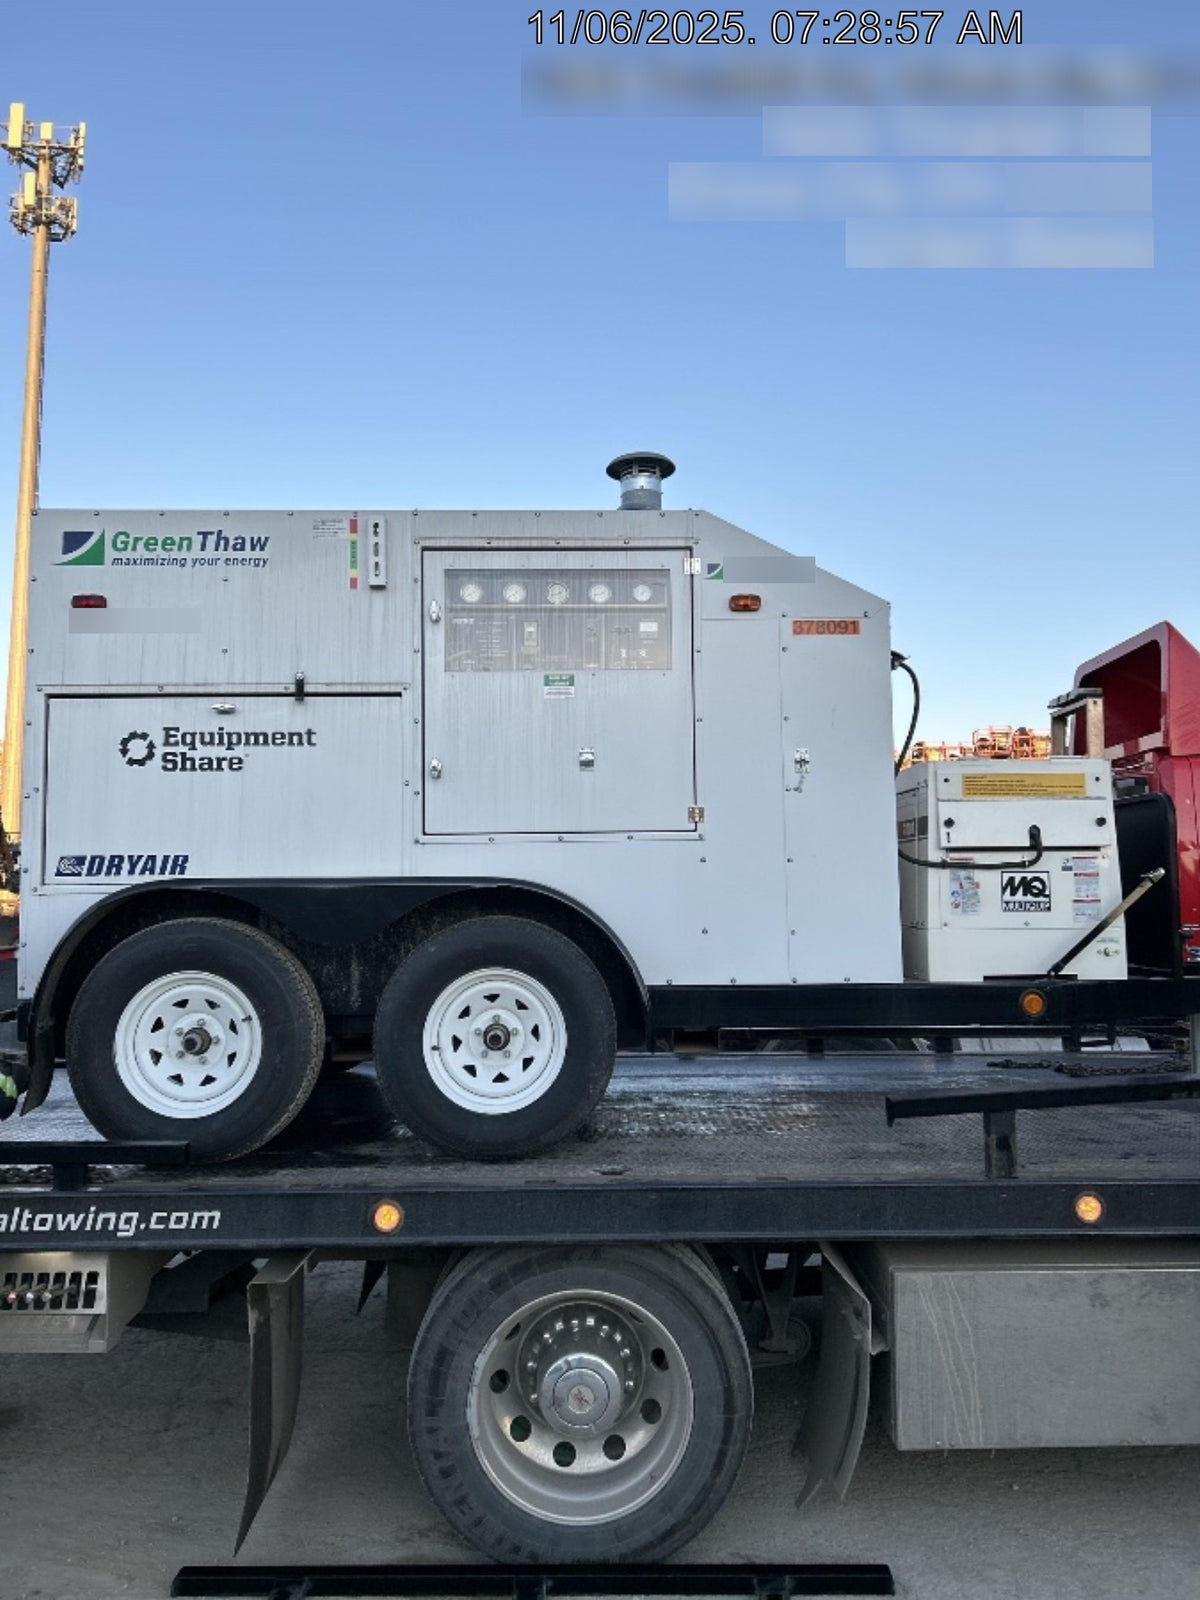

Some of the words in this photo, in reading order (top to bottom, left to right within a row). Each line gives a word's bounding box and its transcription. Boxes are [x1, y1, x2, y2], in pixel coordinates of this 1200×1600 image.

[111, 555, 187, 567] maximizing
[191, 557, 221, 567] your
[224, 557, 269, 568] energy
[793, 620, 859, 635] 378091
[162, 727, 317, 750] Equipment
[161, 752, 244, 772] Share
[85, 855, 189, 877] DRYAIR
[1002, 876, 1049, 898] MQ
